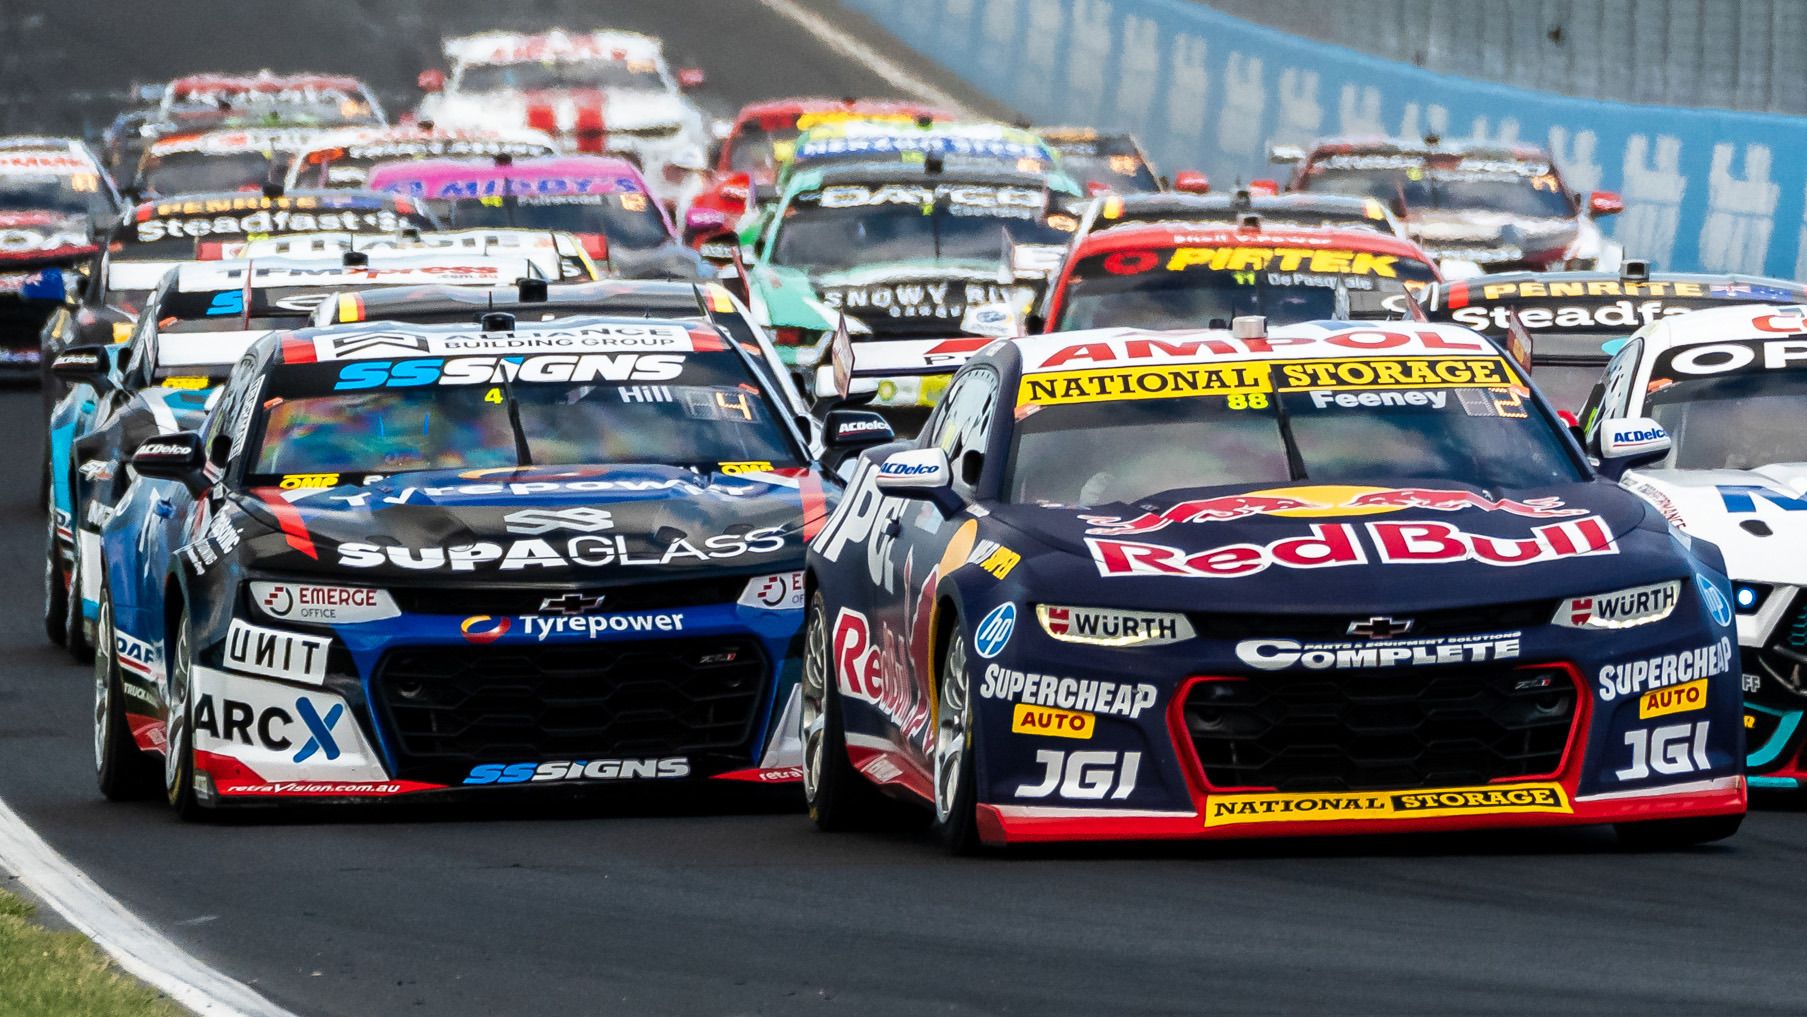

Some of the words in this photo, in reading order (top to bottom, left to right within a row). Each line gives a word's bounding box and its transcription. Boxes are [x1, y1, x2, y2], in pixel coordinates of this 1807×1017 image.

[1167, 247, 1398, 278] PIRTEK
[824, 283, 948, 308] SNOWY
[1484, 281, 1703, 299] PENRITE
[445, 338, 573, 349] BUILDING
[581, 338, 675, 347] GROUP
[1039, 332, 1483, 368] AMPOL
[1026, 368, 1258, 401] NATIONAL
[1288, 360, 1502, 388] STORAGE
[484, 388, 503, 404] 4
[618, 386, 673, 402] Hill
[1227, 393, 1269, 410] 88
[1310, 389, 1447, 409] Feeney
[135, 444, 192, 454] ACDelco
[279, 473, 340, 488] OMP
[879, 462, 939, 475] ACDelco
[1087, 523, 1367, 577] Red
[1367, 515, 1620, 567] Bull
[299, 587, 377, 606] EMERGE
[1597, 585, 1675, 618] WÜRTH
[301, 608, 336, 619] OFFICE
[1075, 613, 1177, 639] WÜRTH
[519, 612, 684, 641] Tyrepower
[1366, 638, 1444, 648] EQUIPMENT
[1447, 631, 1522, 643] SOLUTIONS
[1235, 639, 1520, 671] COMPLETE
[1599, 636, 1733, 701] SUPERCHEAP
[980, 663, 1158, 719] SUPERCHEAP
[1646, 686, 1700, 711] AUTO
[194, 693, 344, 764] ARCX
[1020, 711, 1086, 731] AUTO
[1615, 720, 1711, 781] JGI
[1014, 749, 1141, 800] JGI
[227, 782, 400, 793] retraVision.com.au
[1213, 797, 1386, 817] NATIONAL
[1403, 788, 1555, 809] STORAGE
